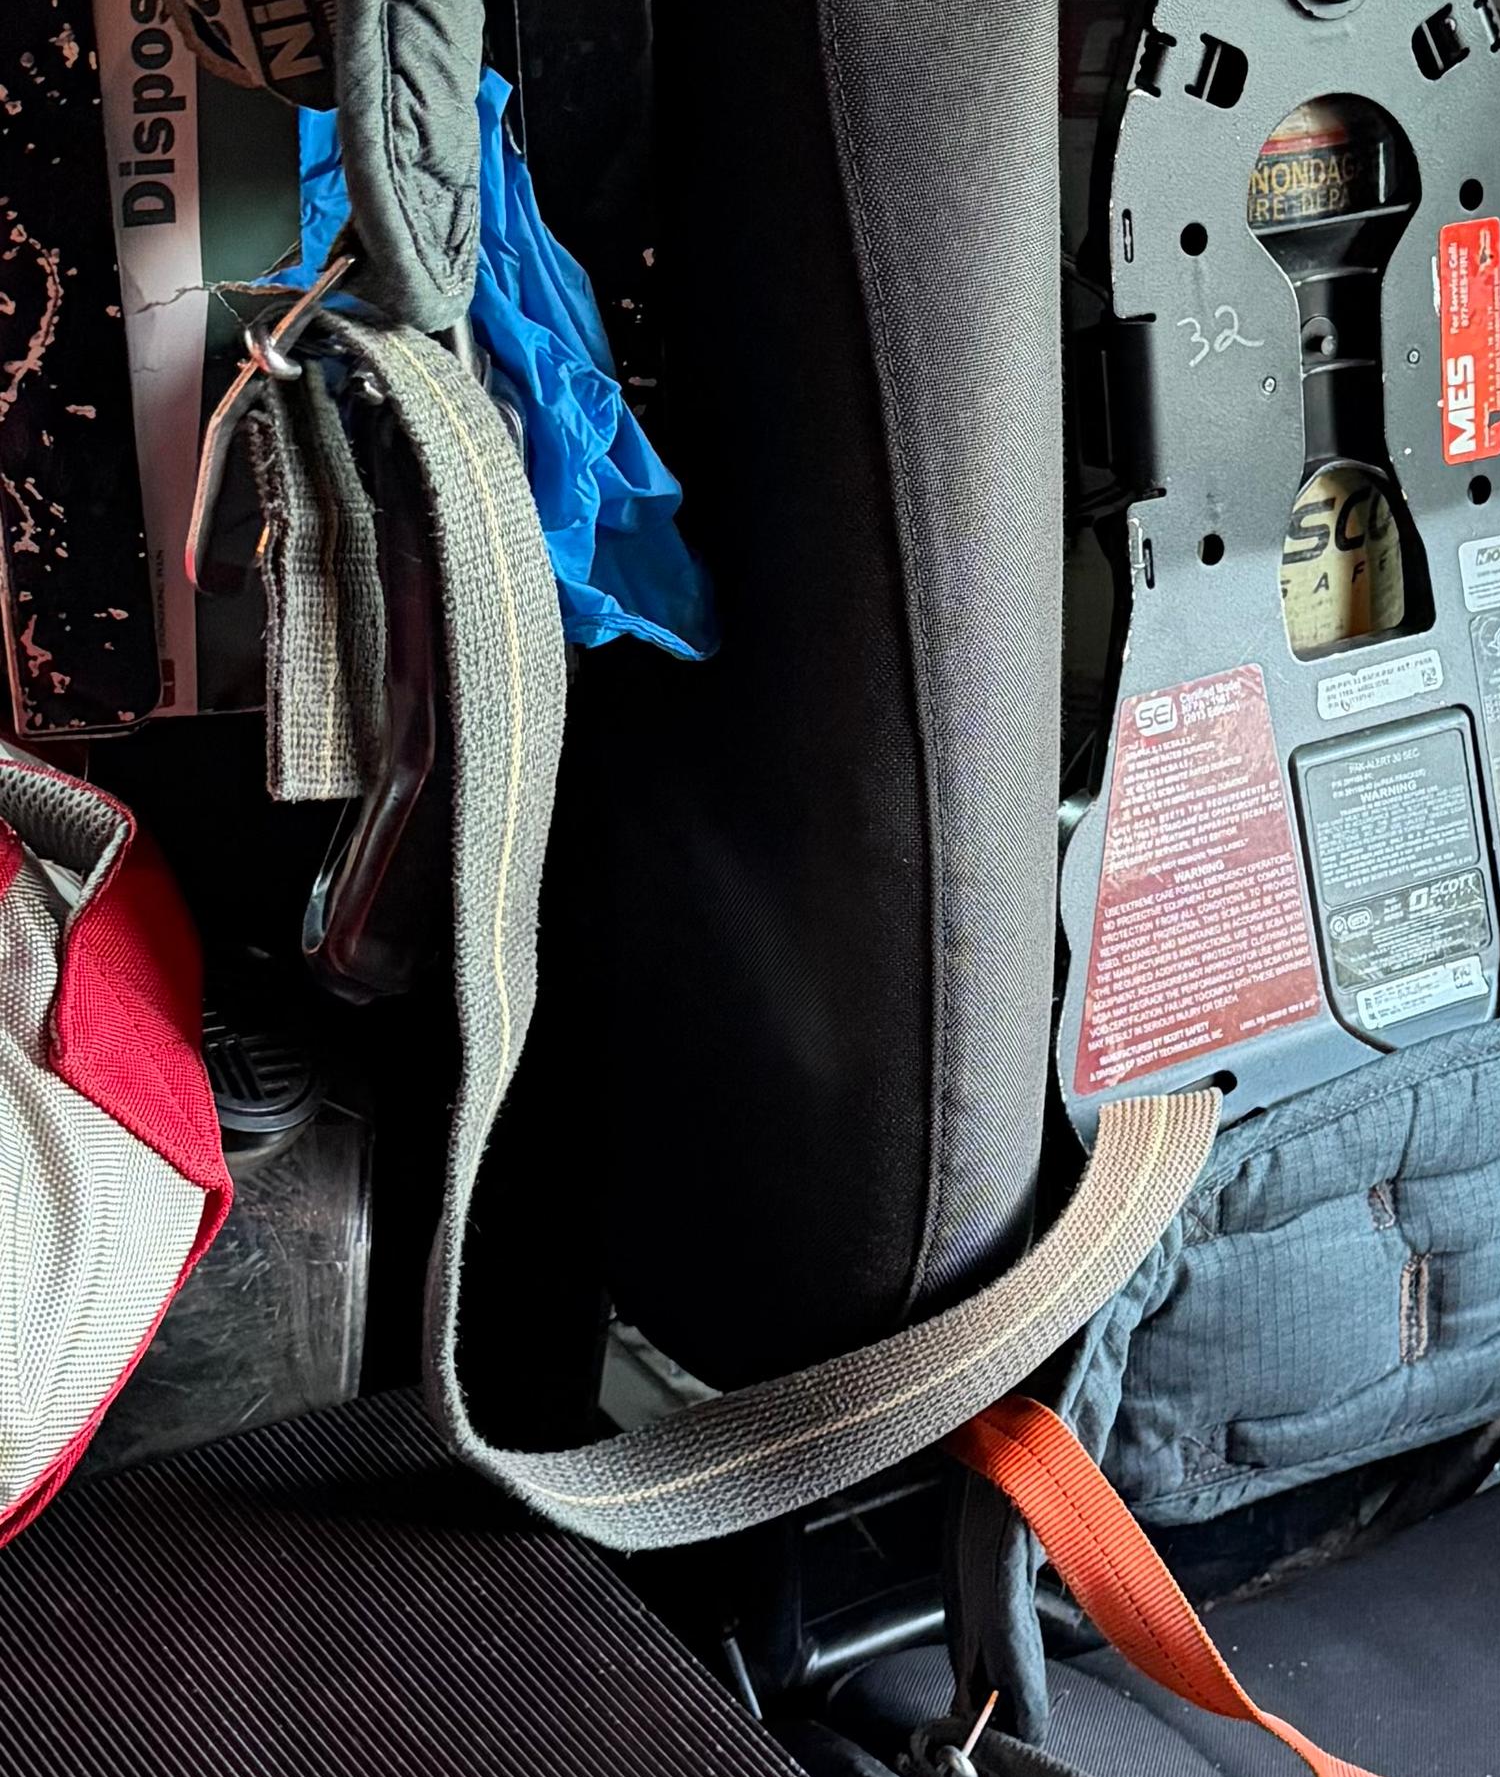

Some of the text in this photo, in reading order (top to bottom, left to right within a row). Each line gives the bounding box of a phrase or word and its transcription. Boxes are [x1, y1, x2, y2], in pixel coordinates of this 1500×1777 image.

[1177, 305, 1265, 367] 32
[1446, 353, 1477, 456] MES
[1137, 701, 1173, 730] SEI
[1359, 778, 1417, 804] WARNING
[1428, 871, 1477, 898] SCOTT
